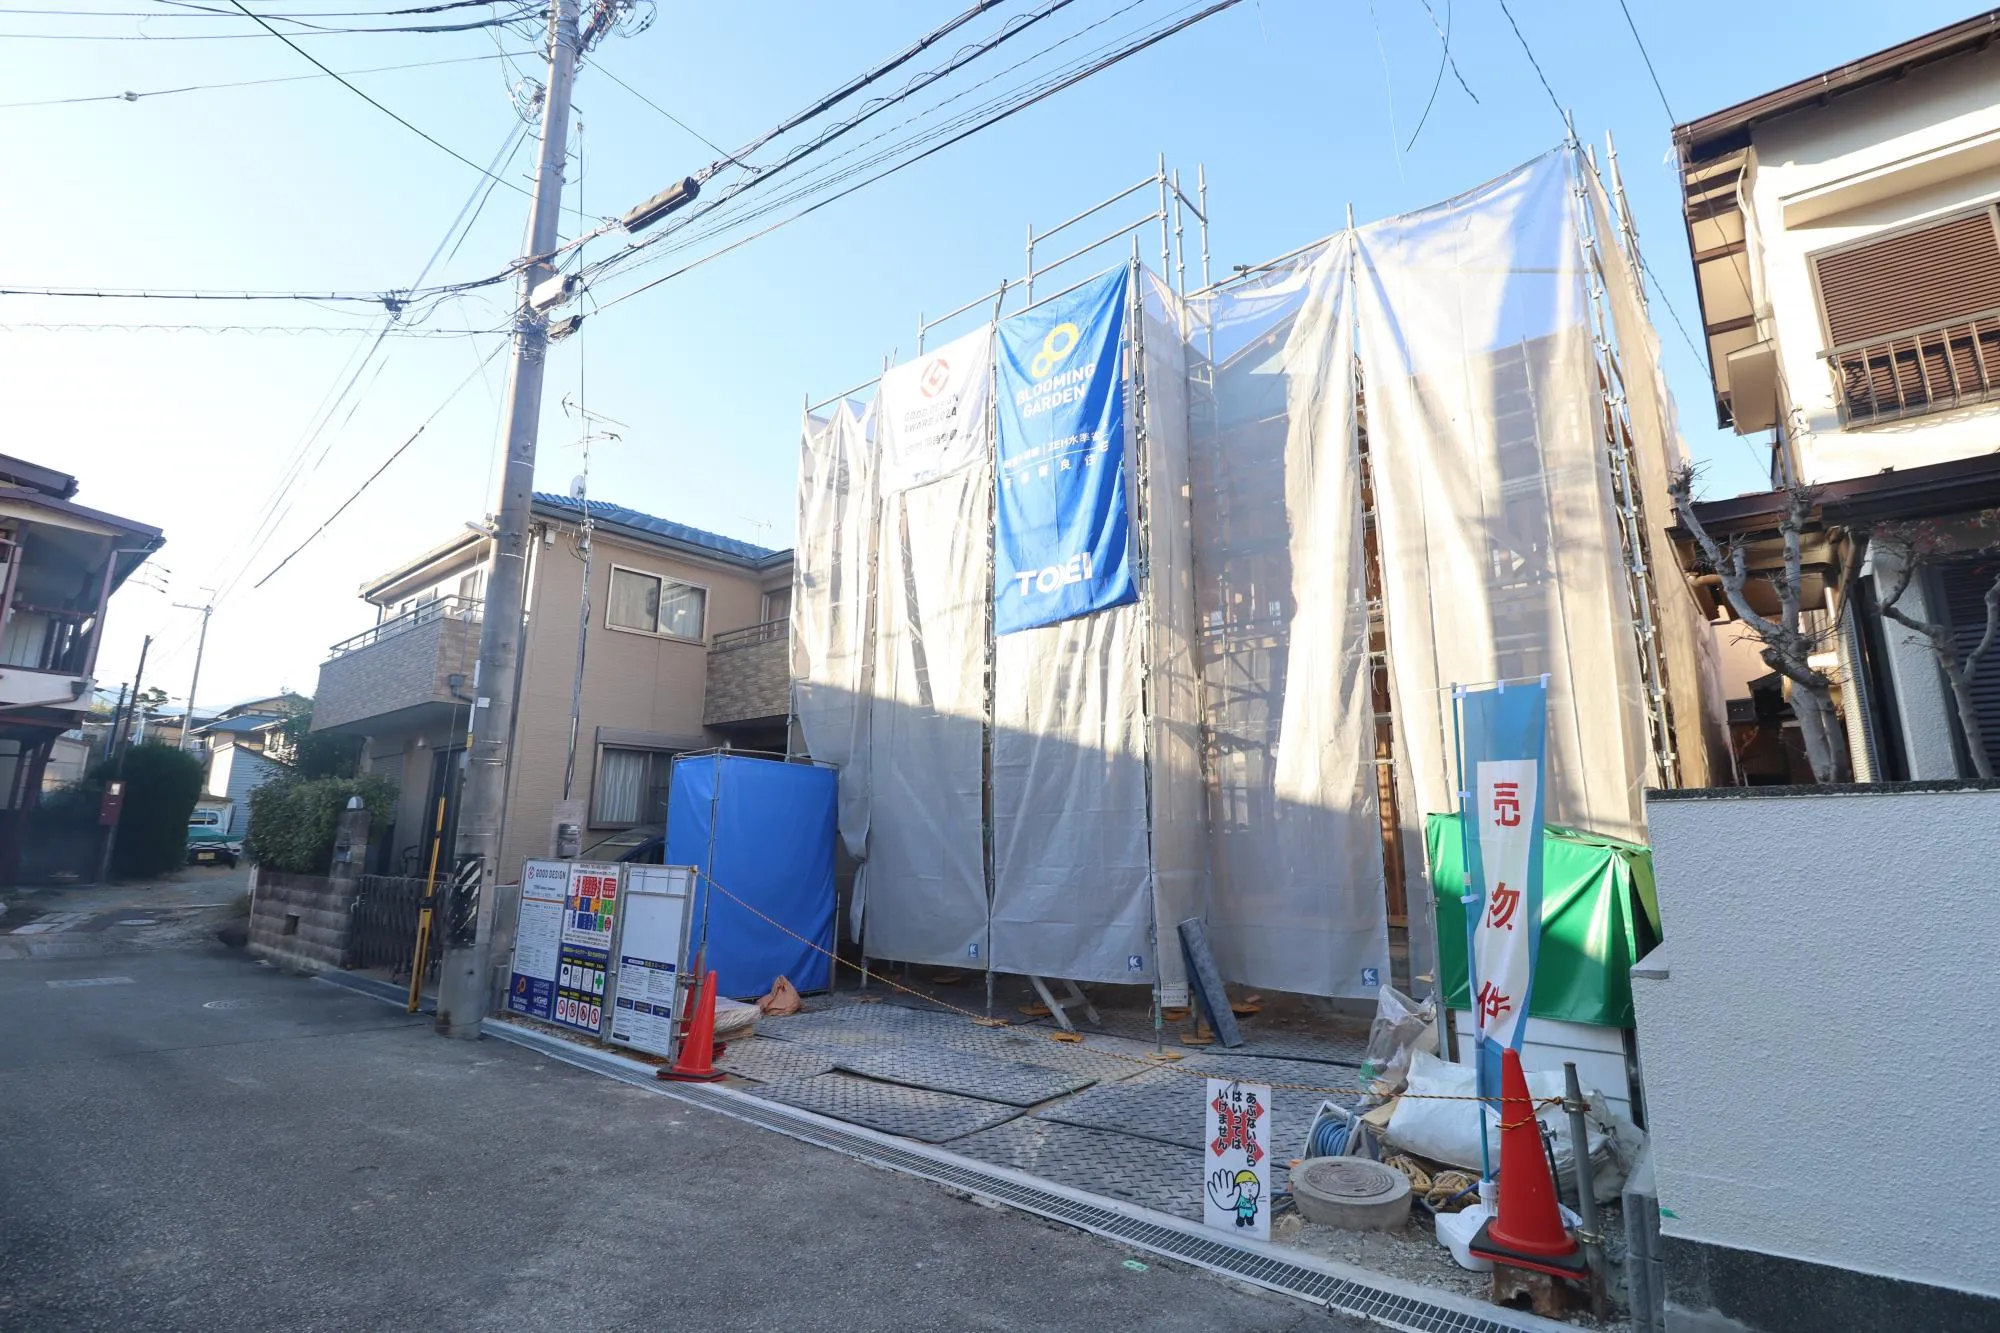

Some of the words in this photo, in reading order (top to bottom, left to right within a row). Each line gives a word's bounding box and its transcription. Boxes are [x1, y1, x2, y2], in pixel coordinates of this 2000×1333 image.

[1016, 363, 1096, 406] BLOOMING
[1023, 383, 1087, 418] GARDEN
[1015, 551, 1093, 597] TOEI
[535, 867, 549, 879] GOOD
[550, 869, 566, 880] DESIGN
[1217, 1089, 1229, 1151] いけません
[1231, 1091, 1242, 1150] はいっては
[1245, 1092, 1257, 1167] あぶないから
